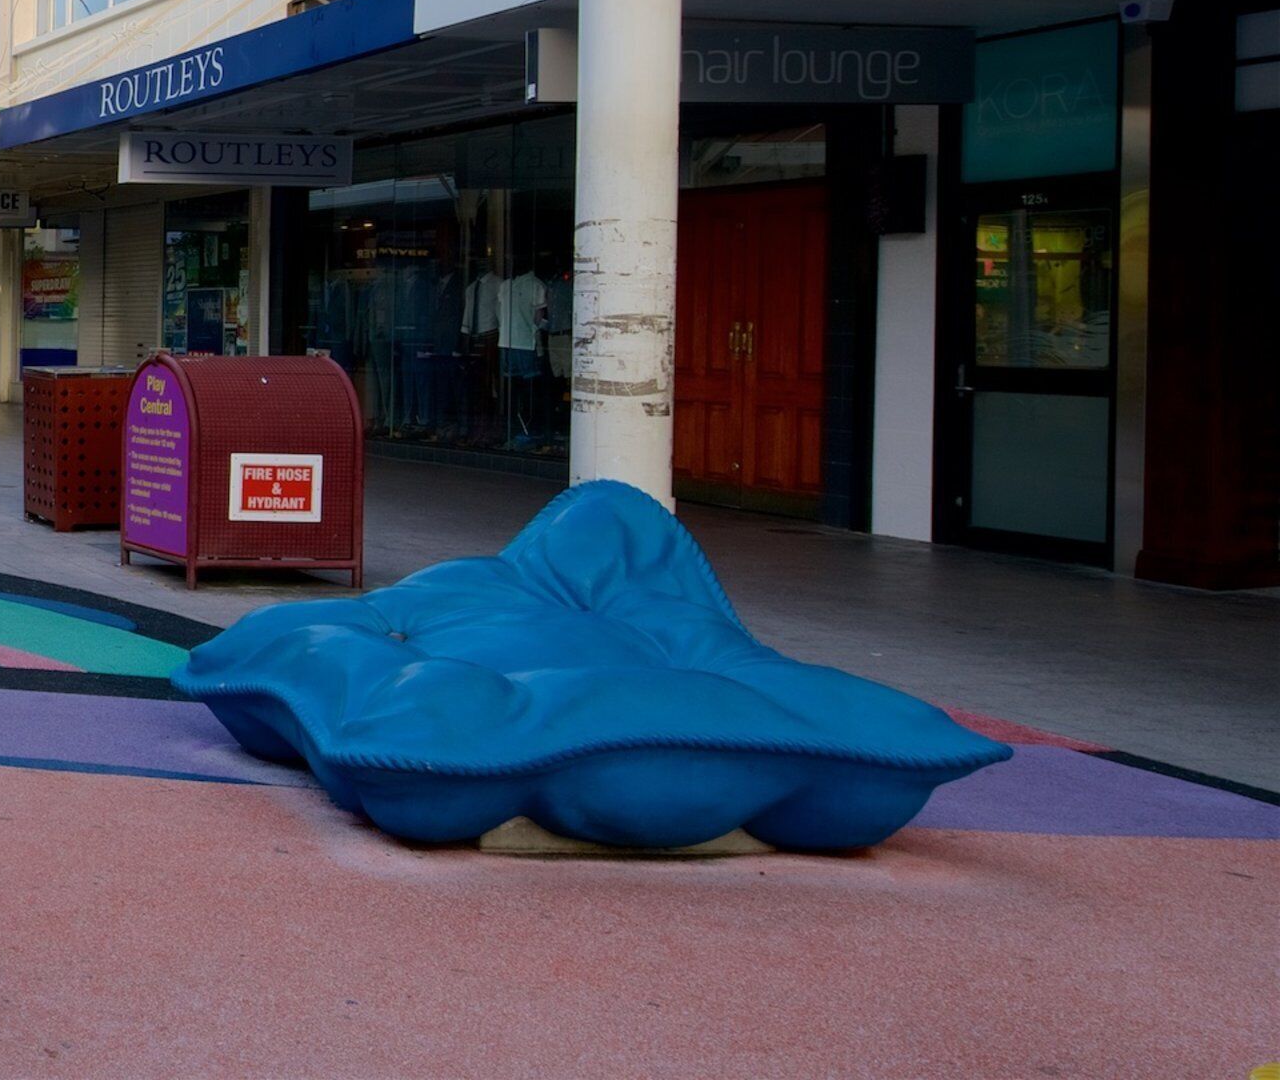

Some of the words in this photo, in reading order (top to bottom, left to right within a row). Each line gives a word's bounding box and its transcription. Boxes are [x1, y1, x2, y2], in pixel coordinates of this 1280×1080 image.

[773, 35, 920, 100] lounge
[100, 46, 224, 118] ROUTLEYS
[977, 66, 1103, 123] KORA
[144, 140, 337, 168] ROUTLEYS
[147, 375, 166, 396] Play
[140, 397, 173, 416] Central
[244, 467, 273, 481] FIRE
[277, 467, 311, 482] HOSE
[271, 482, 283, 495] &
[247, 496, 306, 510] HYDRANT
